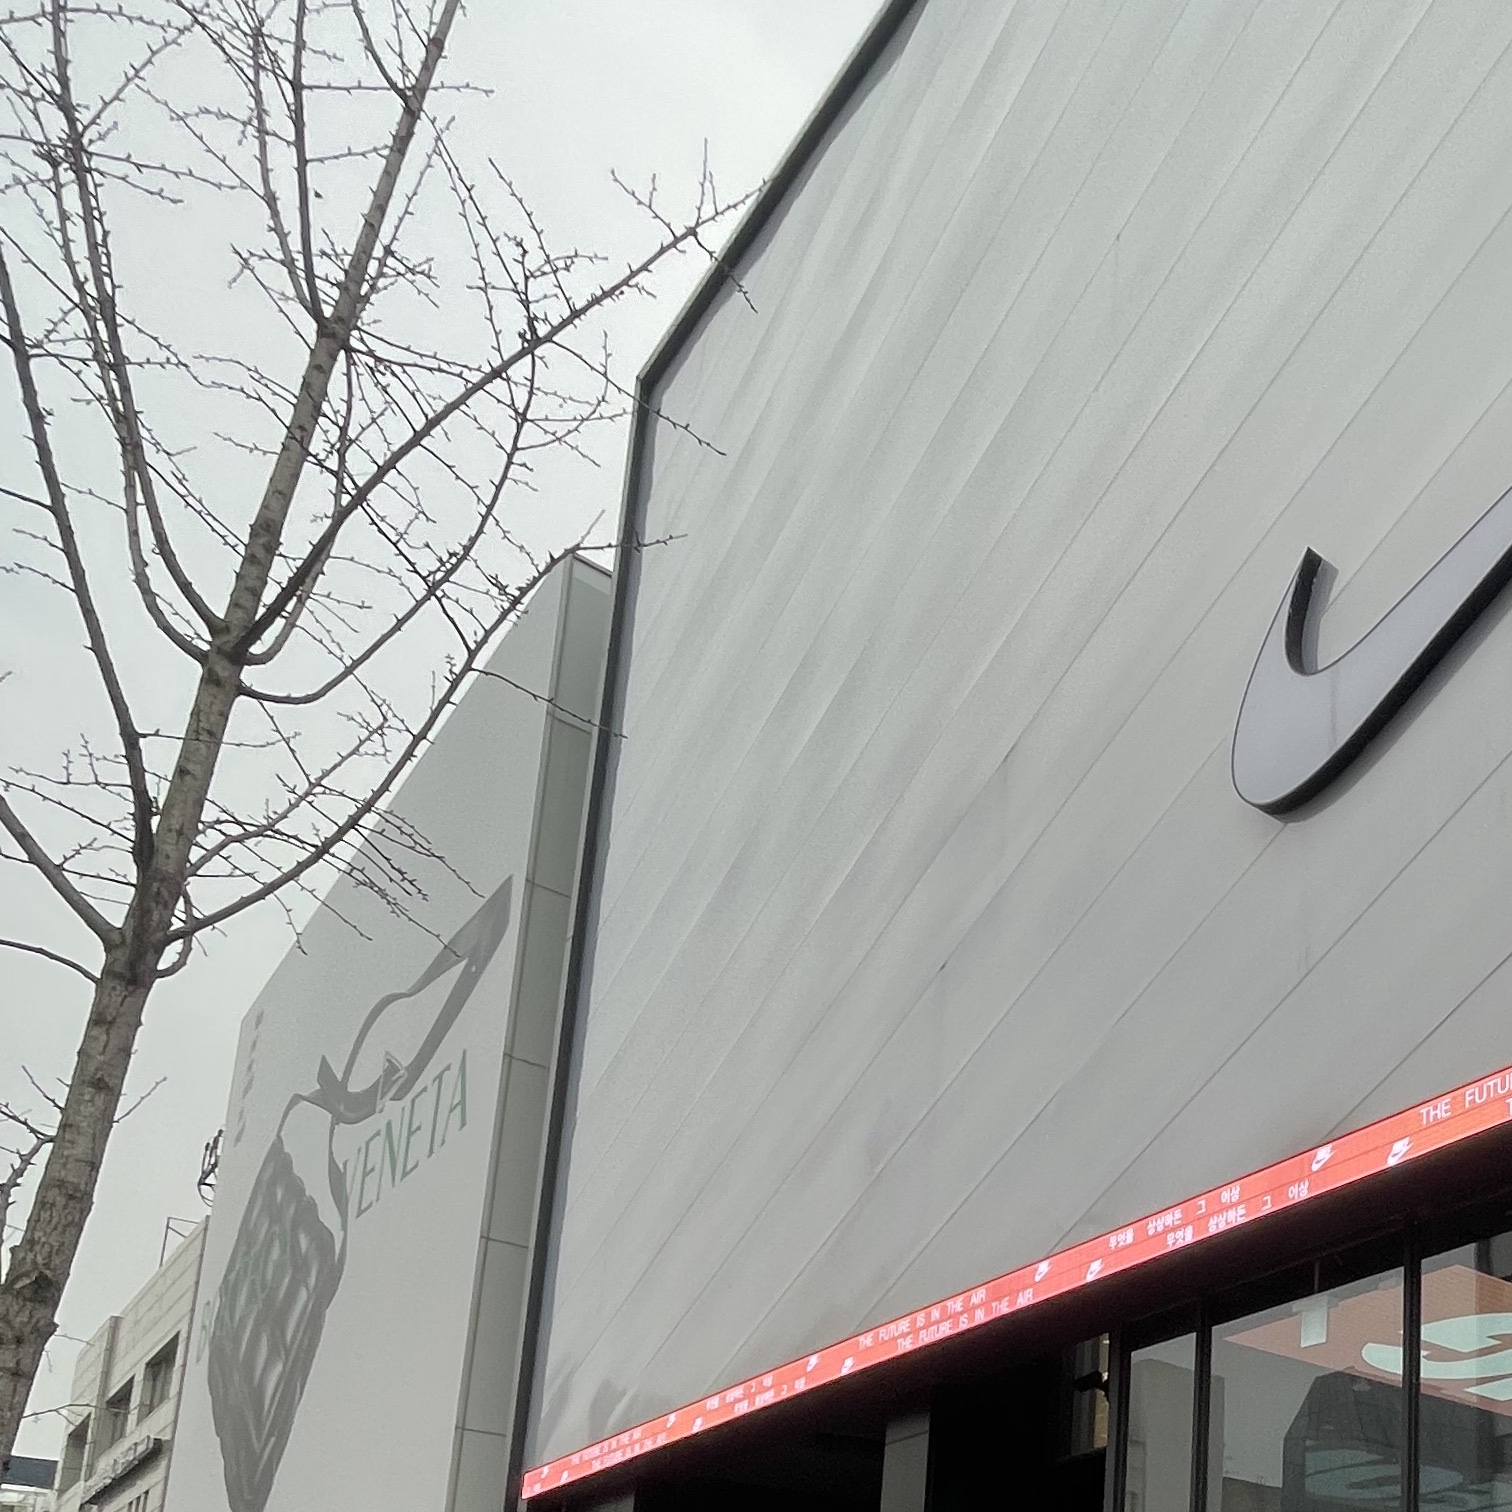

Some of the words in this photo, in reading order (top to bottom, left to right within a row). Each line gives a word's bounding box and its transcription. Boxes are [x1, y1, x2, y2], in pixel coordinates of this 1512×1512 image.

[342, 1048, 467, 1219] VENETA
[1419, 1098, 1451, 1126] THE
[1146, 1209, 1183, 1235] 상상하든
[1196, 1199, 1207, 1214] 그
[1220, 1185, 1241, 1205] 이상
[1207, 1204, 1247, 1233] 상상하든
[1261, 1196, 1272, 1211] 그
[1288, 1179, 1309, 1200] 이상
[858, 1334, 873, 1350] THE
[878, 1319, 911, 1342] FUTURE
[916, 1313, 926, 1328] IS
[930, 1307, 940, 1321] IN
[947, 1298, 964, 1315] THE
[970, 1288, 986, 1306] AIR
[896, 1335, 912, 1352] THE
[918, 1319, 953, 1344] FUTURE
[959, 1313, 968, 1329] IS
[974, 1308, 984, 1323] IN
[991, 1297, 1010, 1314] THE
[1016, 1287, 1034, 1305] AIR
